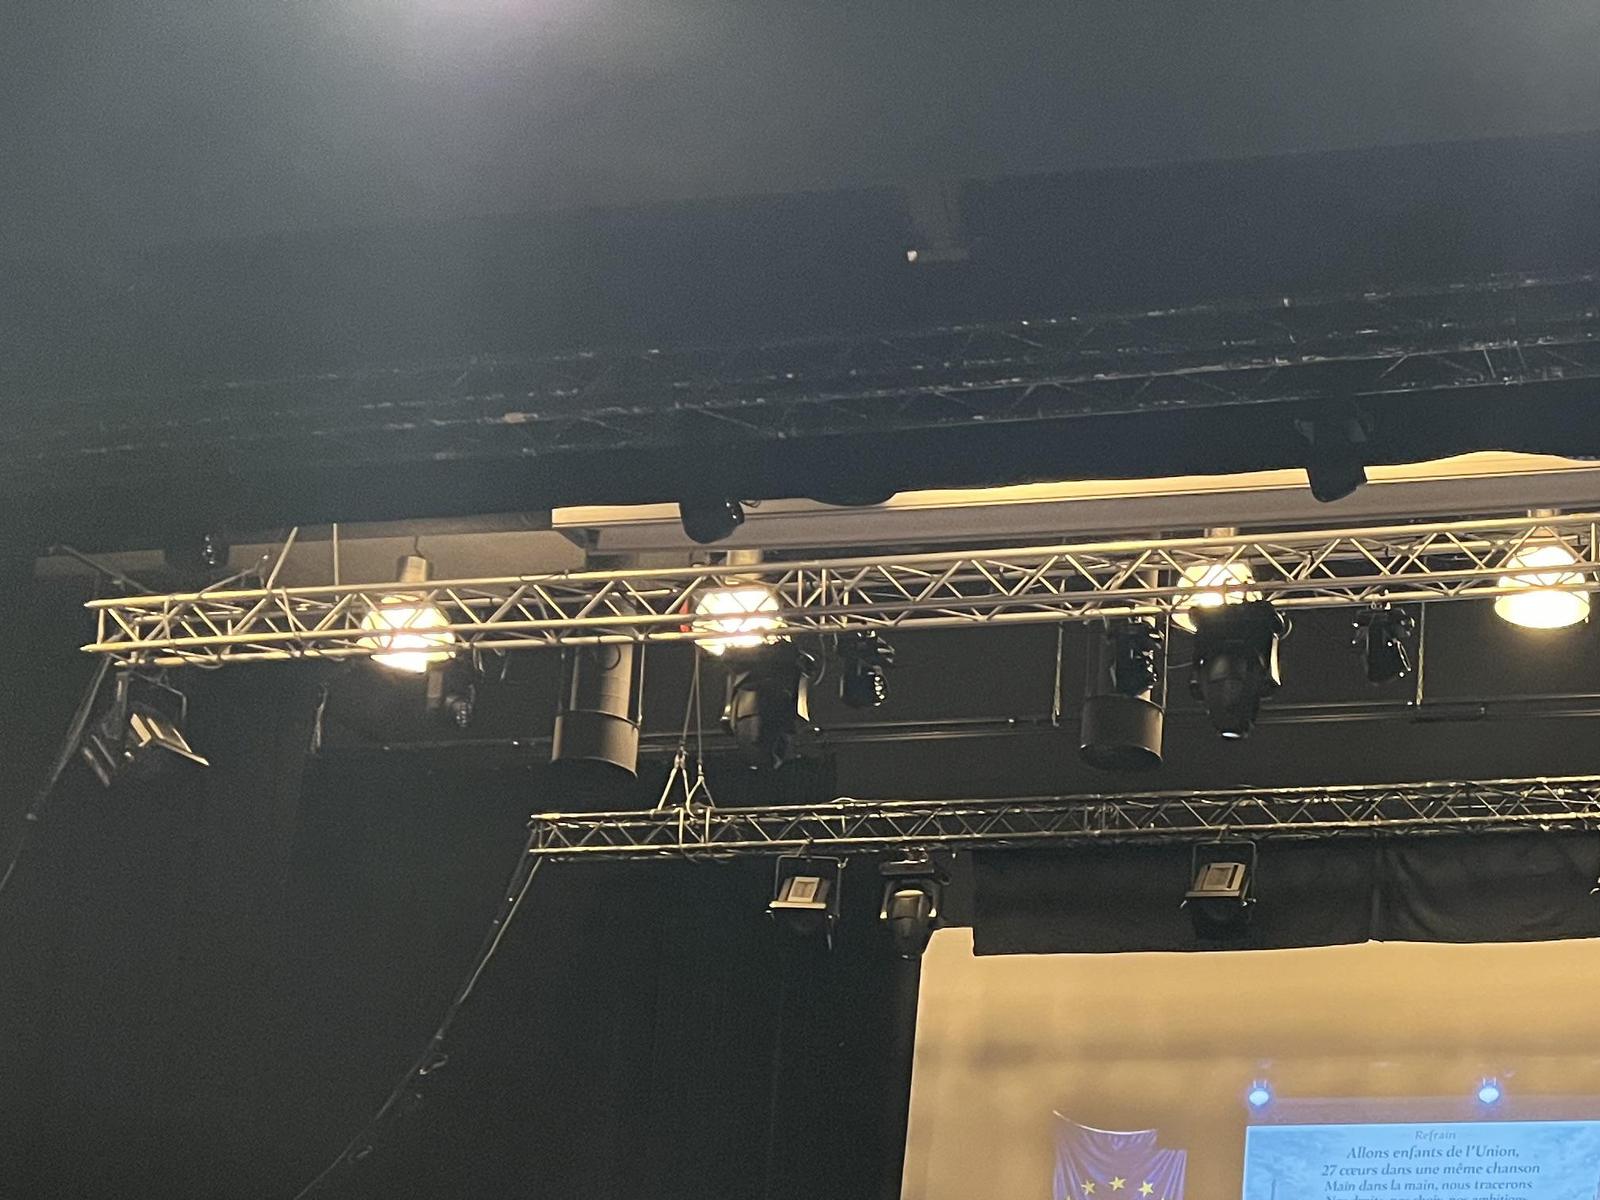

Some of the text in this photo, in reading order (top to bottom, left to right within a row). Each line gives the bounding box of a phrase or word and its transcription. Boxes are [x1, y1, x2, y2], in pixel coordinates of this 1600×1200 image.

[1415, 1130, 1456, 1142] Refrain
[1346, 1146, 1390, 1159] Allons
[1393, 1145, 1443, 1160] enfants
[1446, 1145, 1463, 1157] de
[1321, 1161, 1540, 1176] 27 cœurs dans une même chanson
[1324, 1179, 1533, 1192] Main dans la main, nous tracerons
